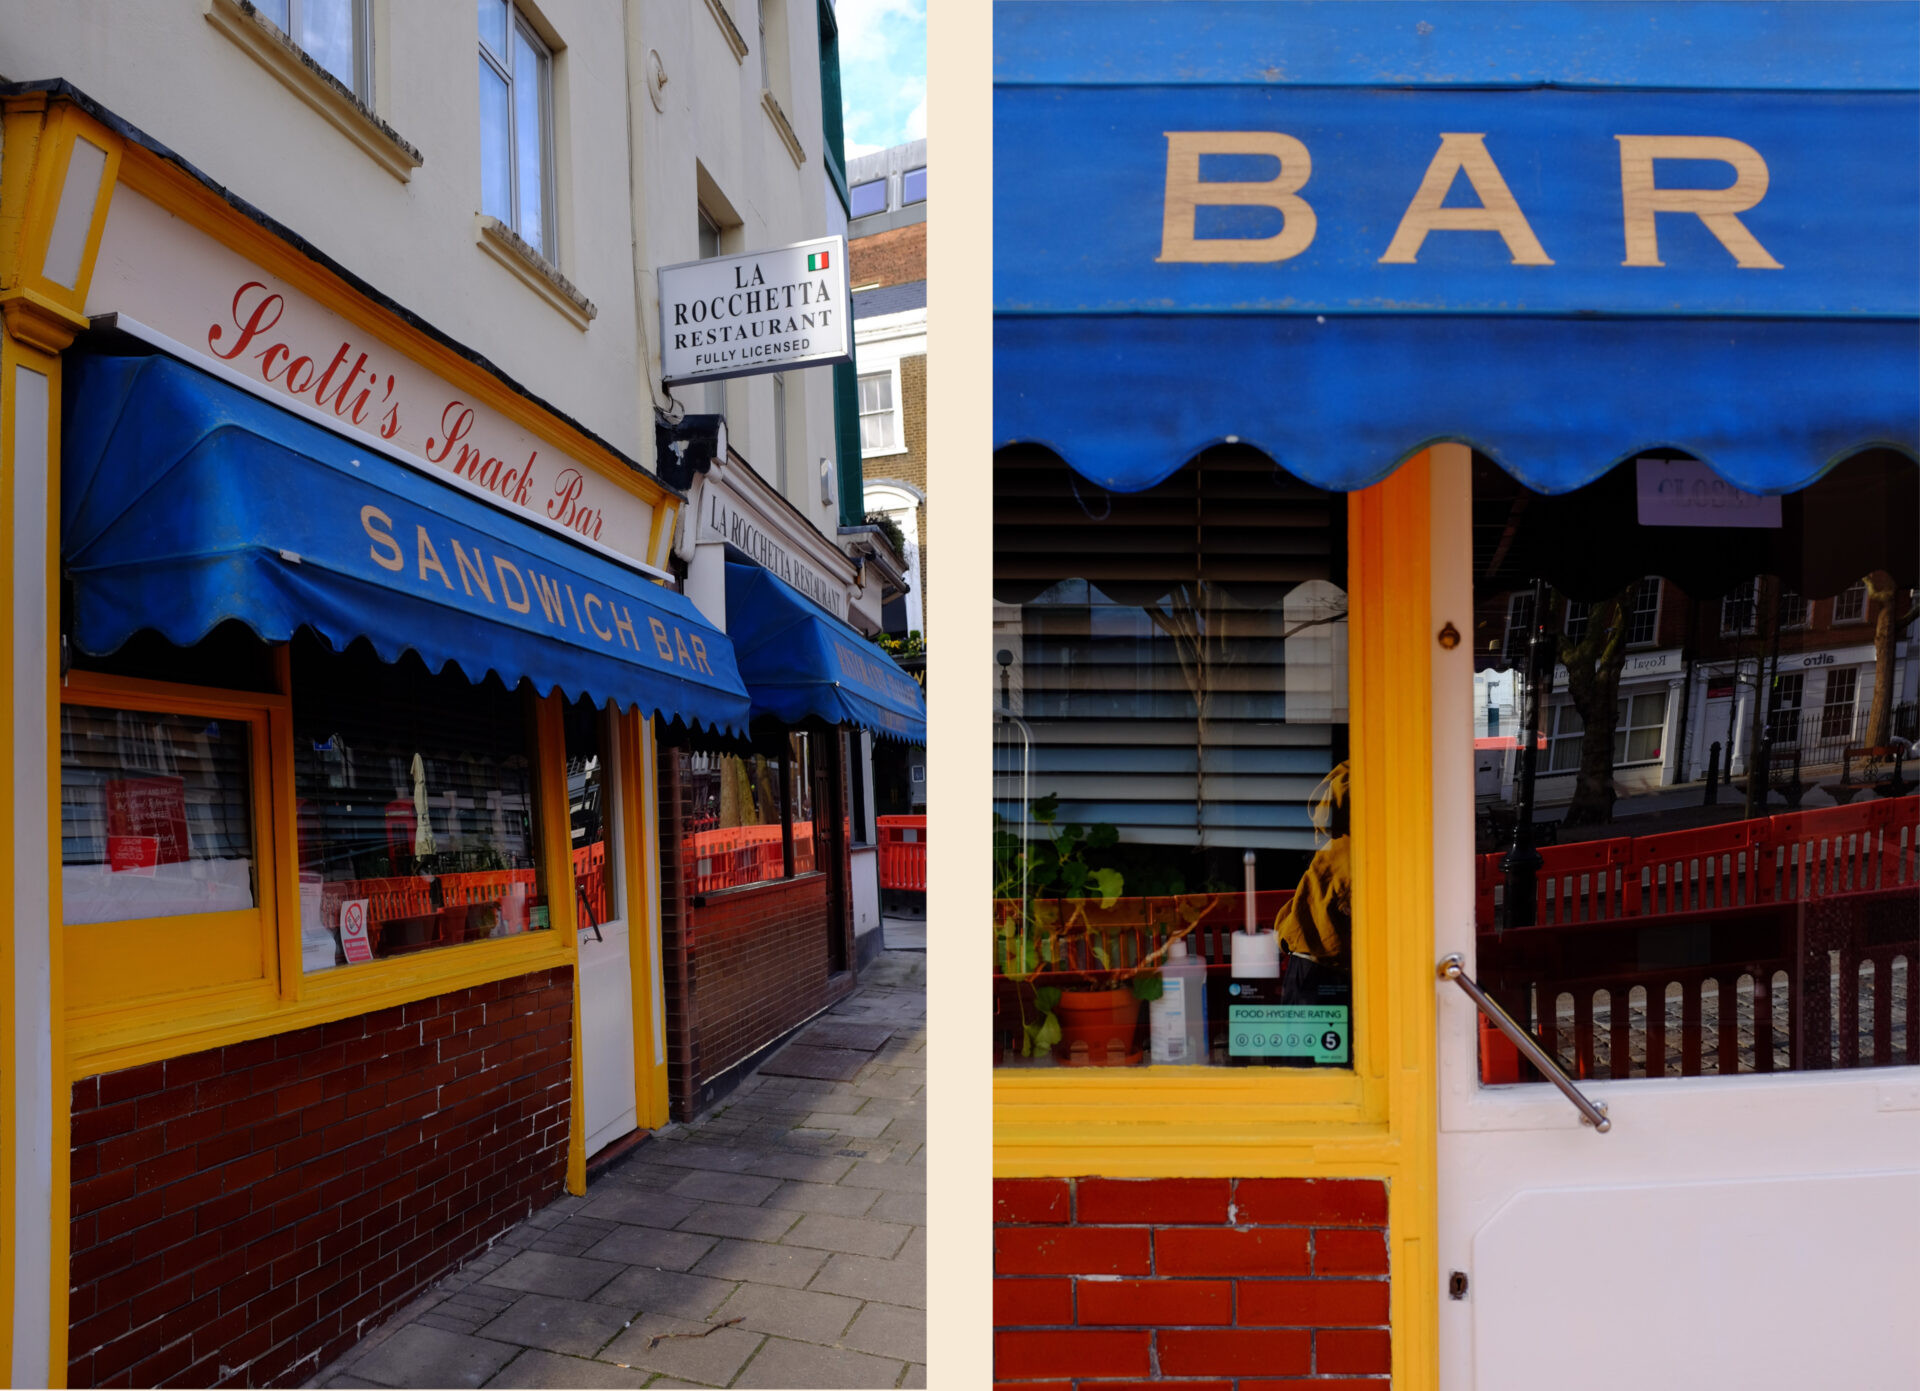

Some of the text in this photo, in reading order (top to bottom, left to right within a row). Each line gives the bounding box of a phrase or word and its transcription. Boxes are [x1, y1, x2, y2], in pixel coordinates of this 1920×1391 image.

[1155, 130, 1785, 269] BAR
[734, 263, 765, 289] LA
[674, 279, 831, 326] ROCCHETTA
[674, 310, 833, 350] RESTAURANT
[695, 338, 810, 366] FULLY LICENSED
[208, 281, 603, 542] Scotti's Snack Bar
[710, 495, 841, 616] LA ROCCHETTA RESTAURANT
[360, 505, 641, 651] SANDWICH
[648, 615, 715, 677] BAR
[1235, 1010, 1342, 1019] FOOD HYGIENE RATING
[1326, 1033, 1337, 1049] 5
